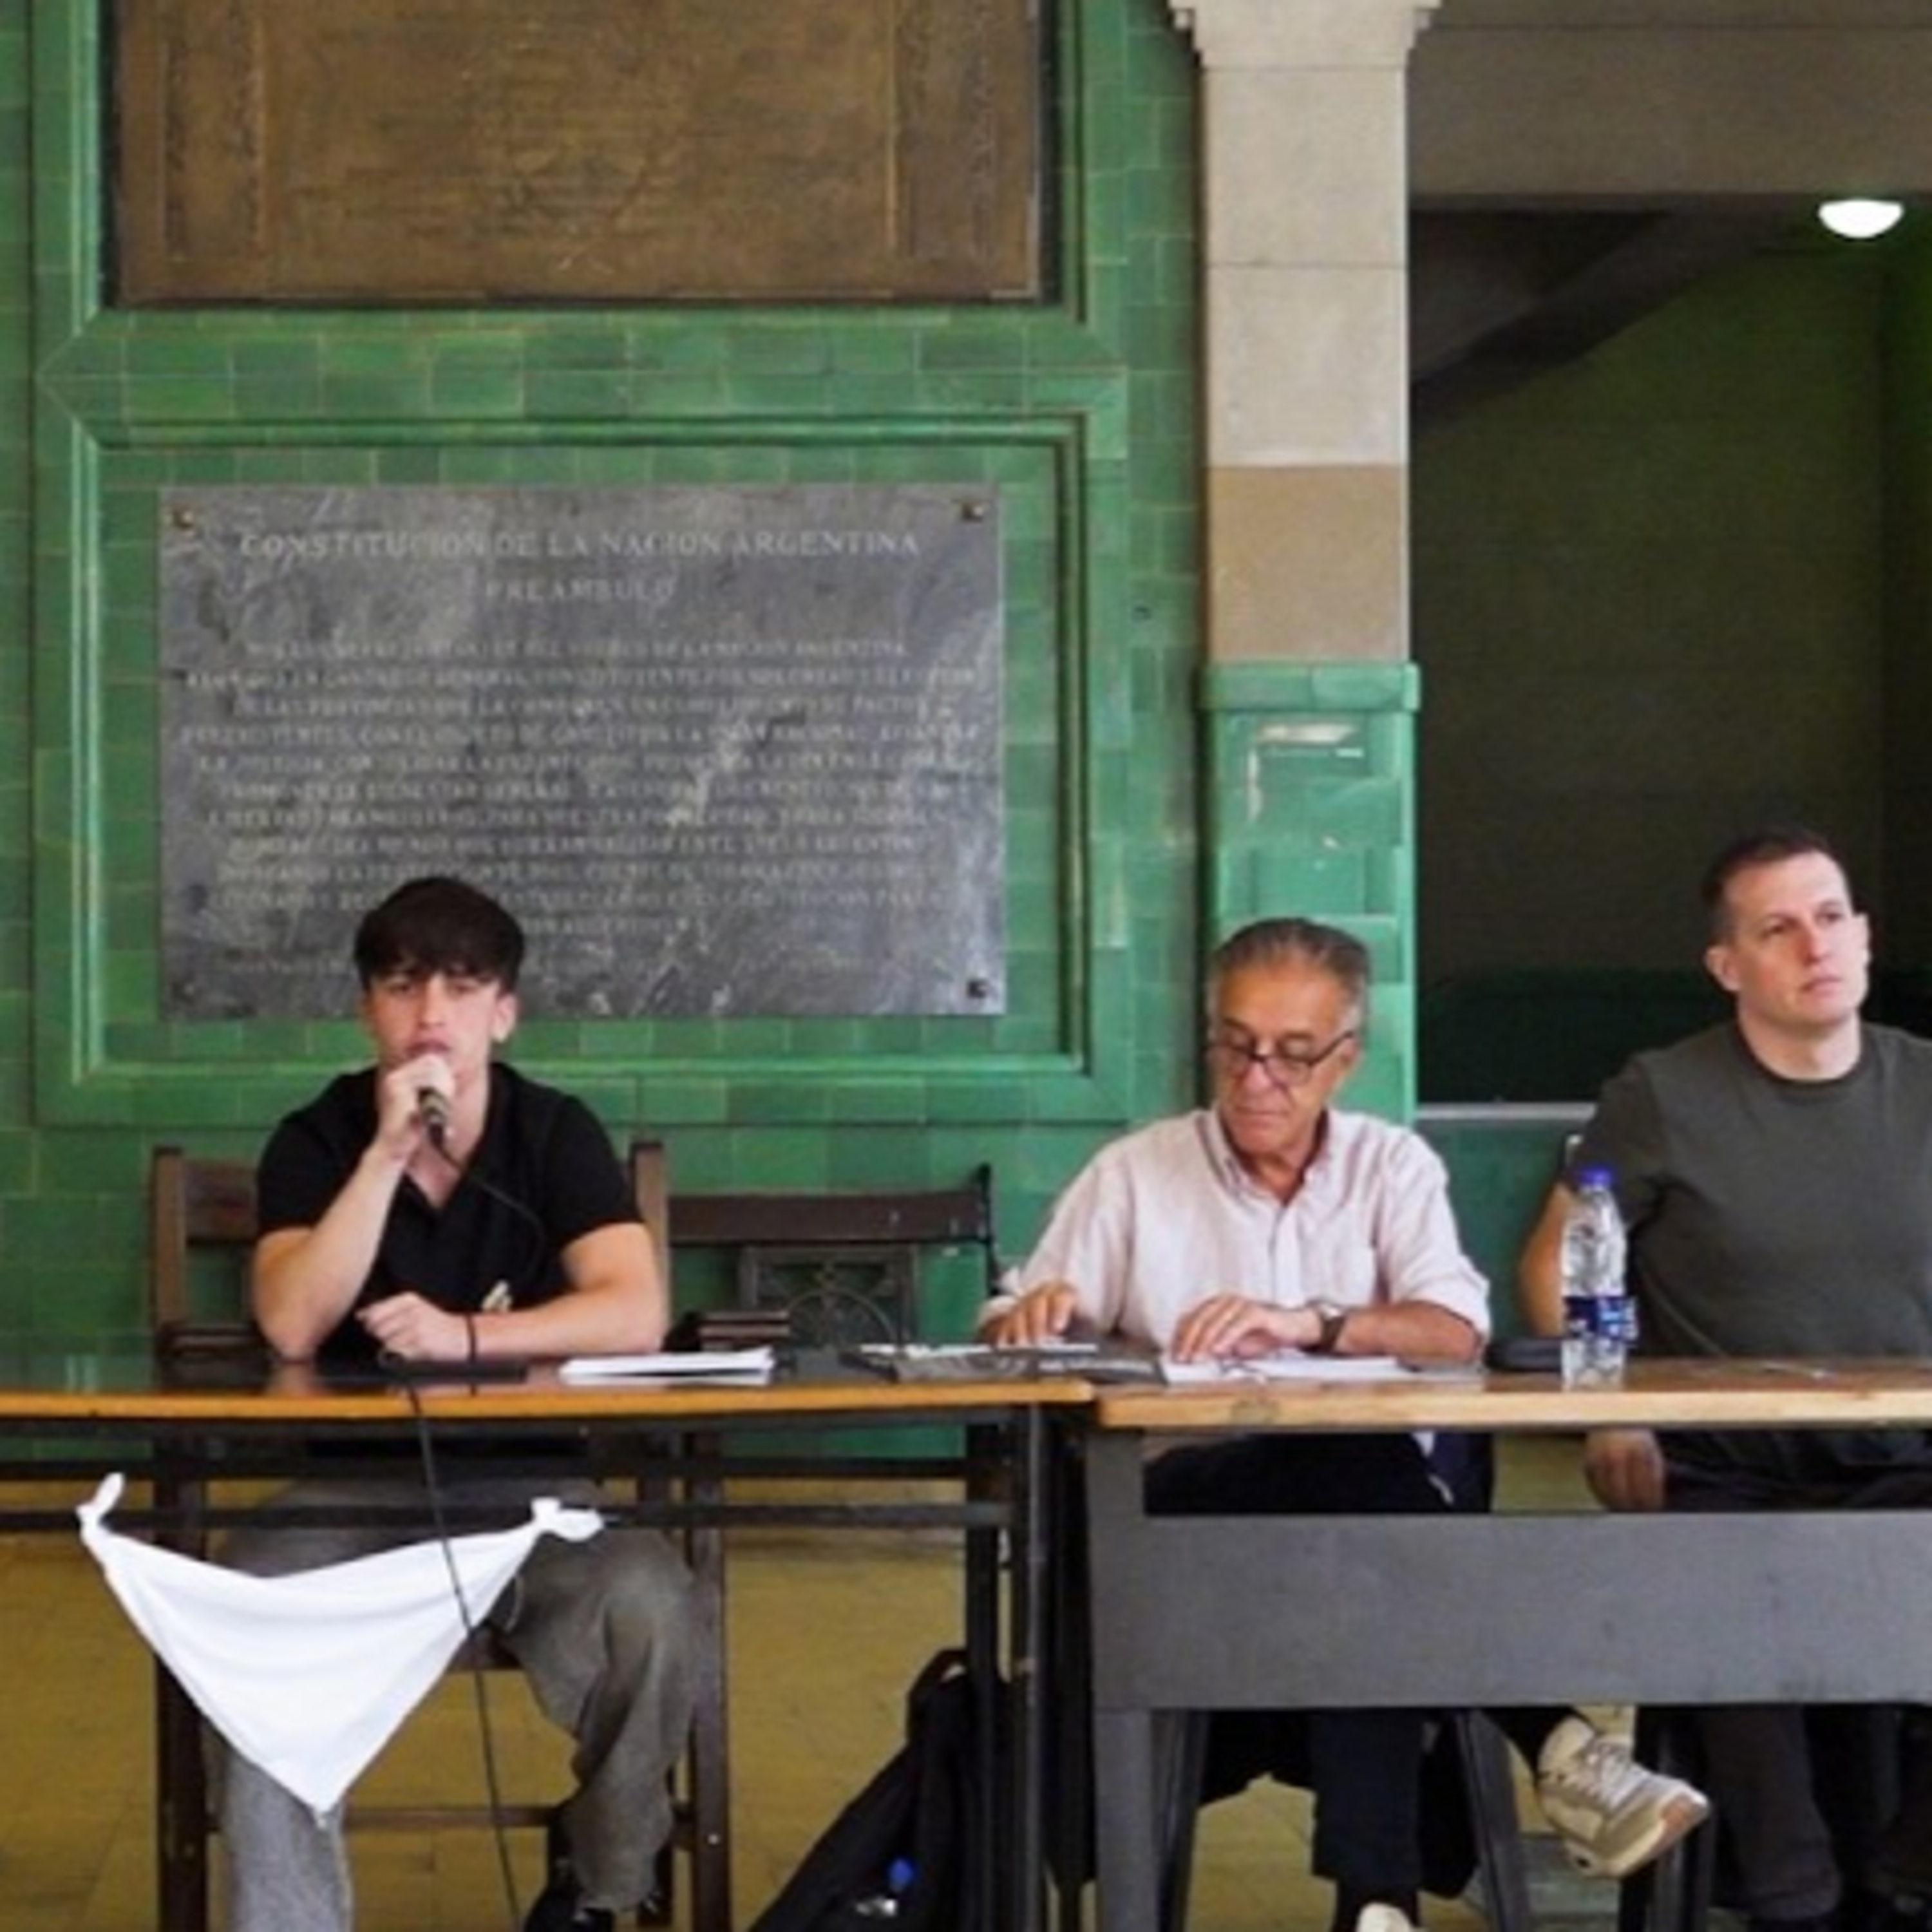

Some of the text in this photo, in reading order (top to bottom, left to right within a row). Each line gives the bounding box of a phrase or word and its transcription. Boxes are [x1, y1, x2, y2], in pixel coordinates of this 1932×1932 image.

[240, 529, 921, 558] CONSTITUCION DE LA NACION ARGENTINA
[486, 578, 676, 603] PREAMBULO
